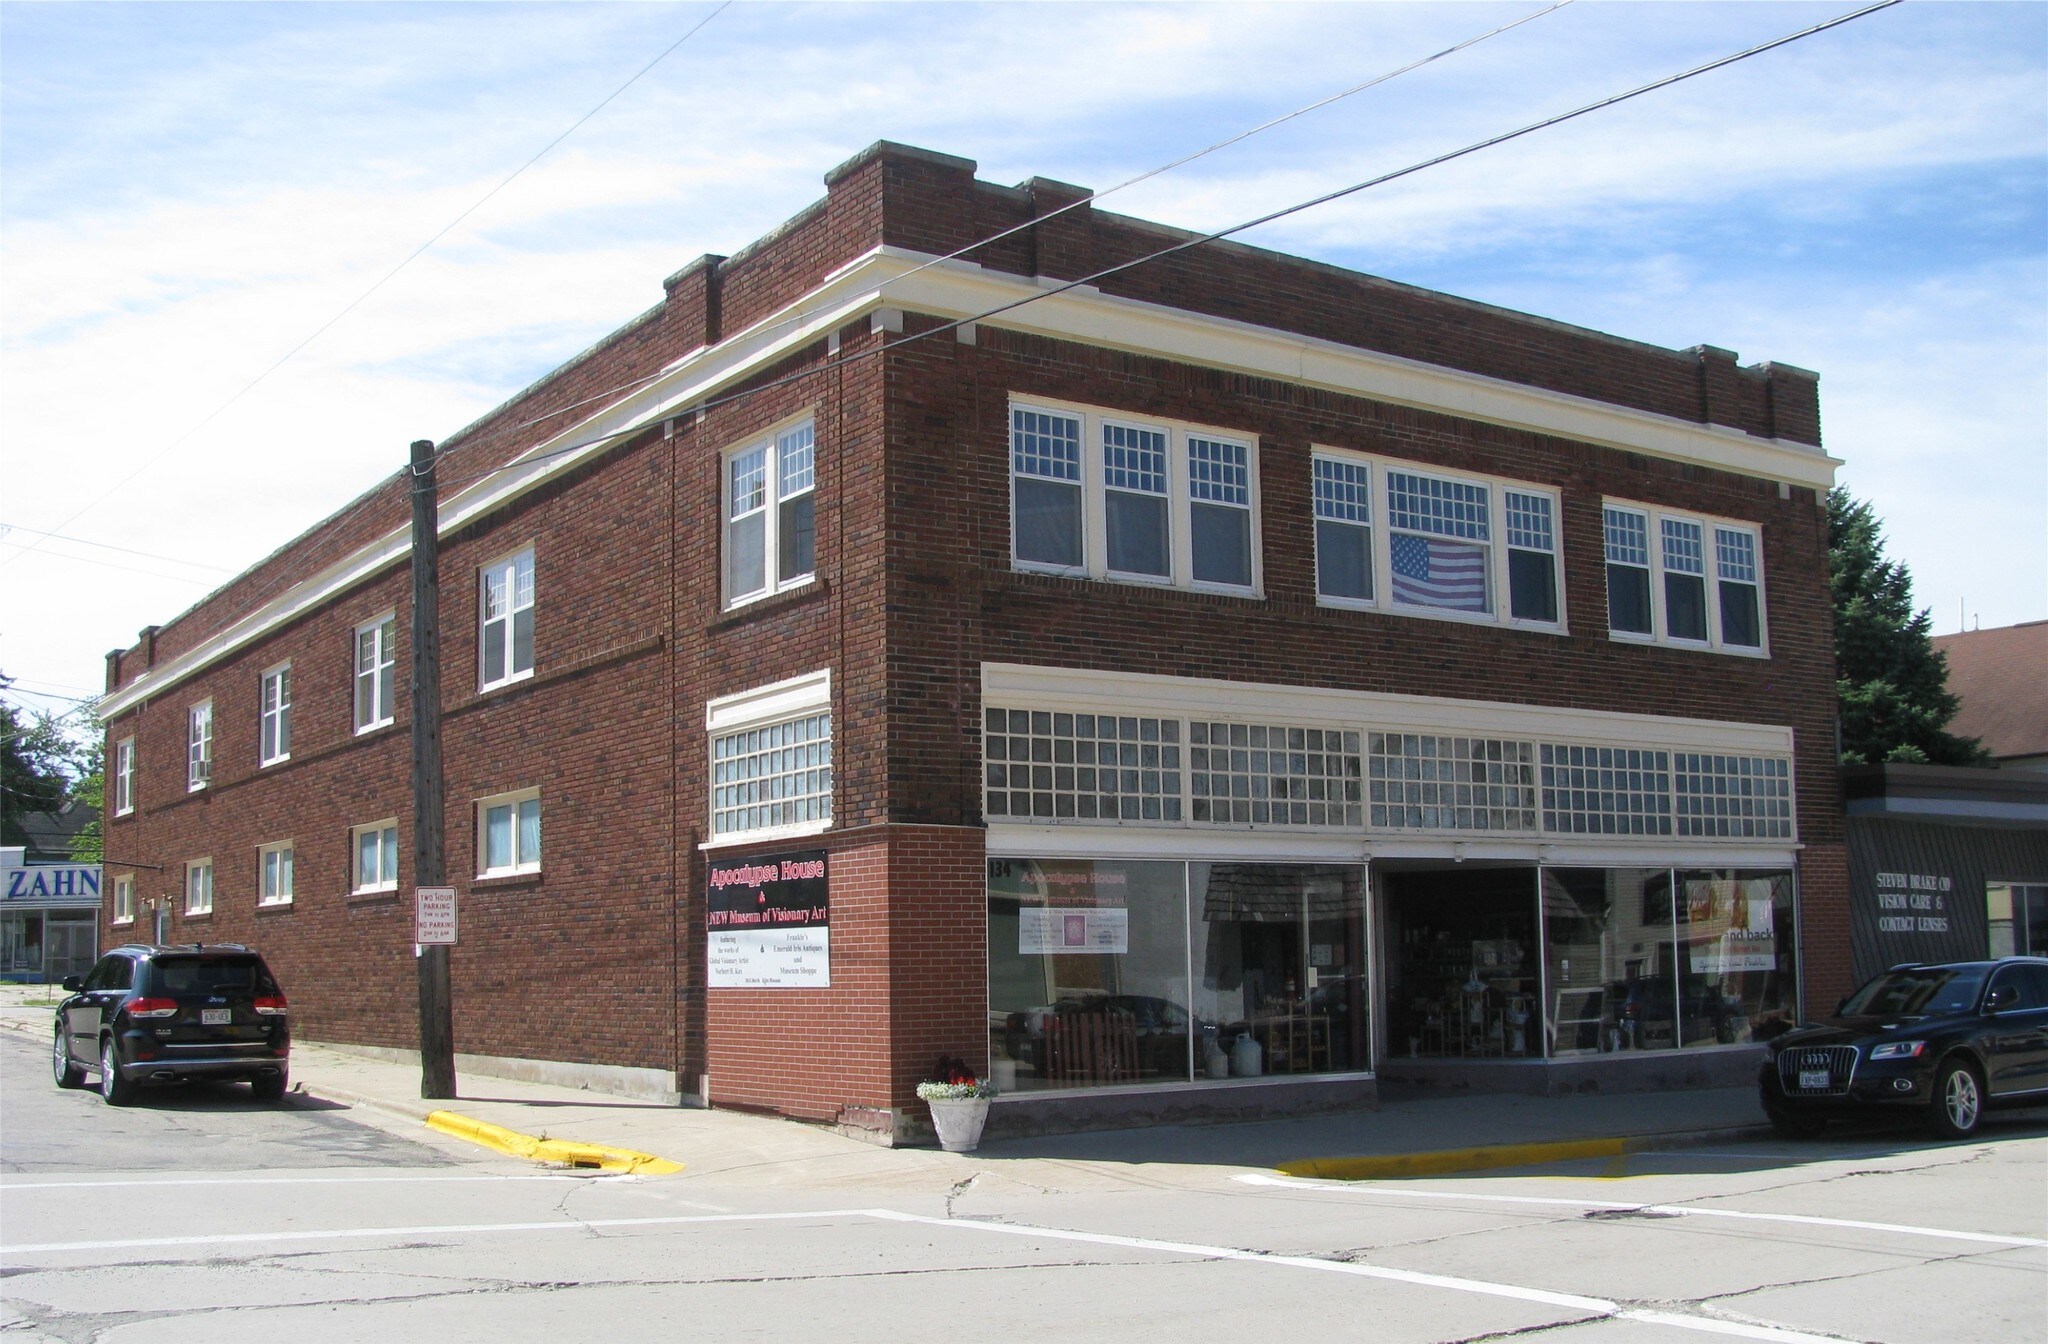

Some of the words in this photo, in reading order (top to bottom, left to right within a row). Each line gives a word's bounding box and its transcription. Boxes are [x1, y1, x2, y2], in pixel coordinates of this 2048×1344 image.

[710, 864, 778, 890] Apocalypse
[781, 860, 825, 881] House
[989, 861, 1011, 878] 134
[1089, 872, 1126, 884] House
[8, 869, 101, 898] ZAHN
[1876, 873, 1907, 888] STEVEN
[1909, 874, 1937, 890] DRAKE
[1878, 894, 1907, 909] VISION
[1910, 894, 1931, 909] CARE
[709, 911, 728, 925] NEW
[729, 909, 760, 924] Museum
[762, 907, 771, 922] of
[771, 906, 810, 923] Visionary
[811, 906, 827, 920] Art
[1879, 917, 1914, 931] CONTACT
[1918, 917, 1948, 932] LENSES
[1746, 928, 1774, 941] back
